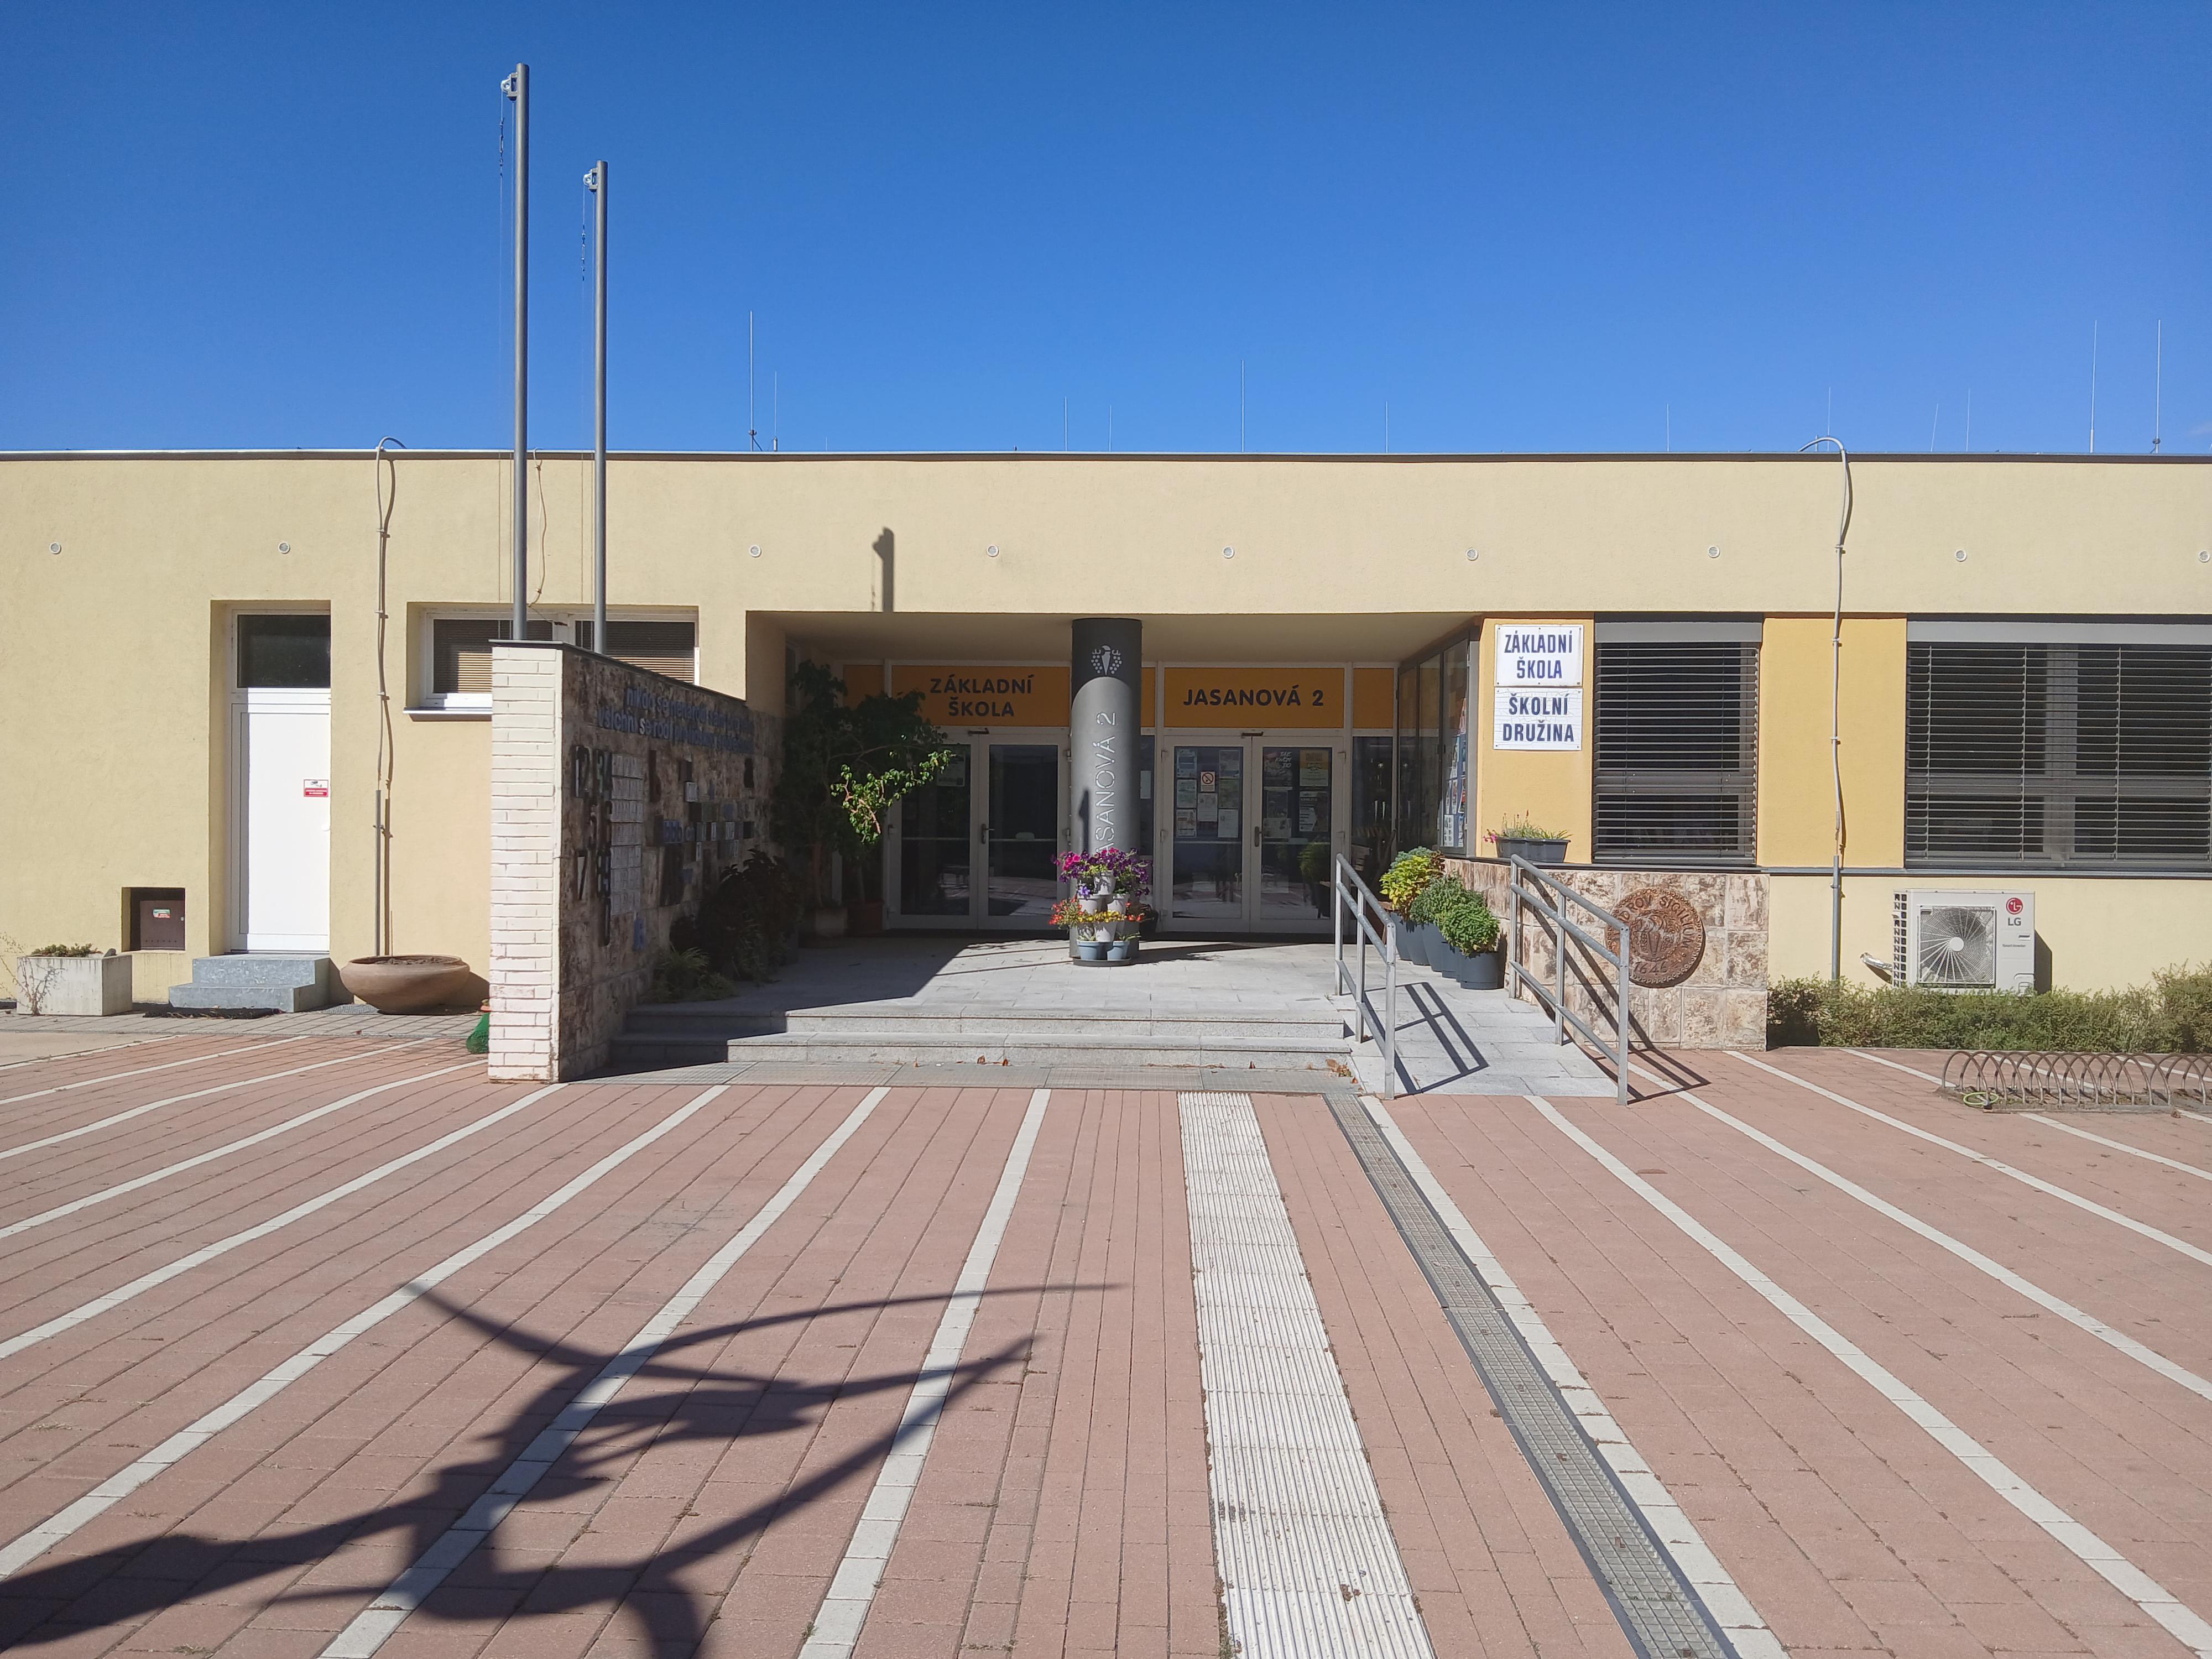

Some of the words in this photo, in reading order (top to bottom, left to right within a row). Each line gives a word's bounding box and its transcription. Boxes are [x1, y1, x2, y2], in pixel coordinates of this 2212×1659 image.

[1504, 630, 1573, 654] ZÁKLADNÍ
[1517, 656, 1562, 679] ŠKOLA
[930, 674, 1034, 694] ZÁKLADNÍ
[948, 697, 1015, 717] ŠKOLA
[1183, 685, 1301, 706] JASANOVÁ
[1312, 690, 1324, 707] 2
[1509, 693, 1569, 716] ŠKOLNÍ
[1096, 711, 1117, 726] 2
[1503, 720, 1574, 742] DRUŽINA
[1092, 735, 1116, 856] ASANOVÁ
[2007, 917, 2022, 926] LG
[1633, 961, 1668, 974] 1646
